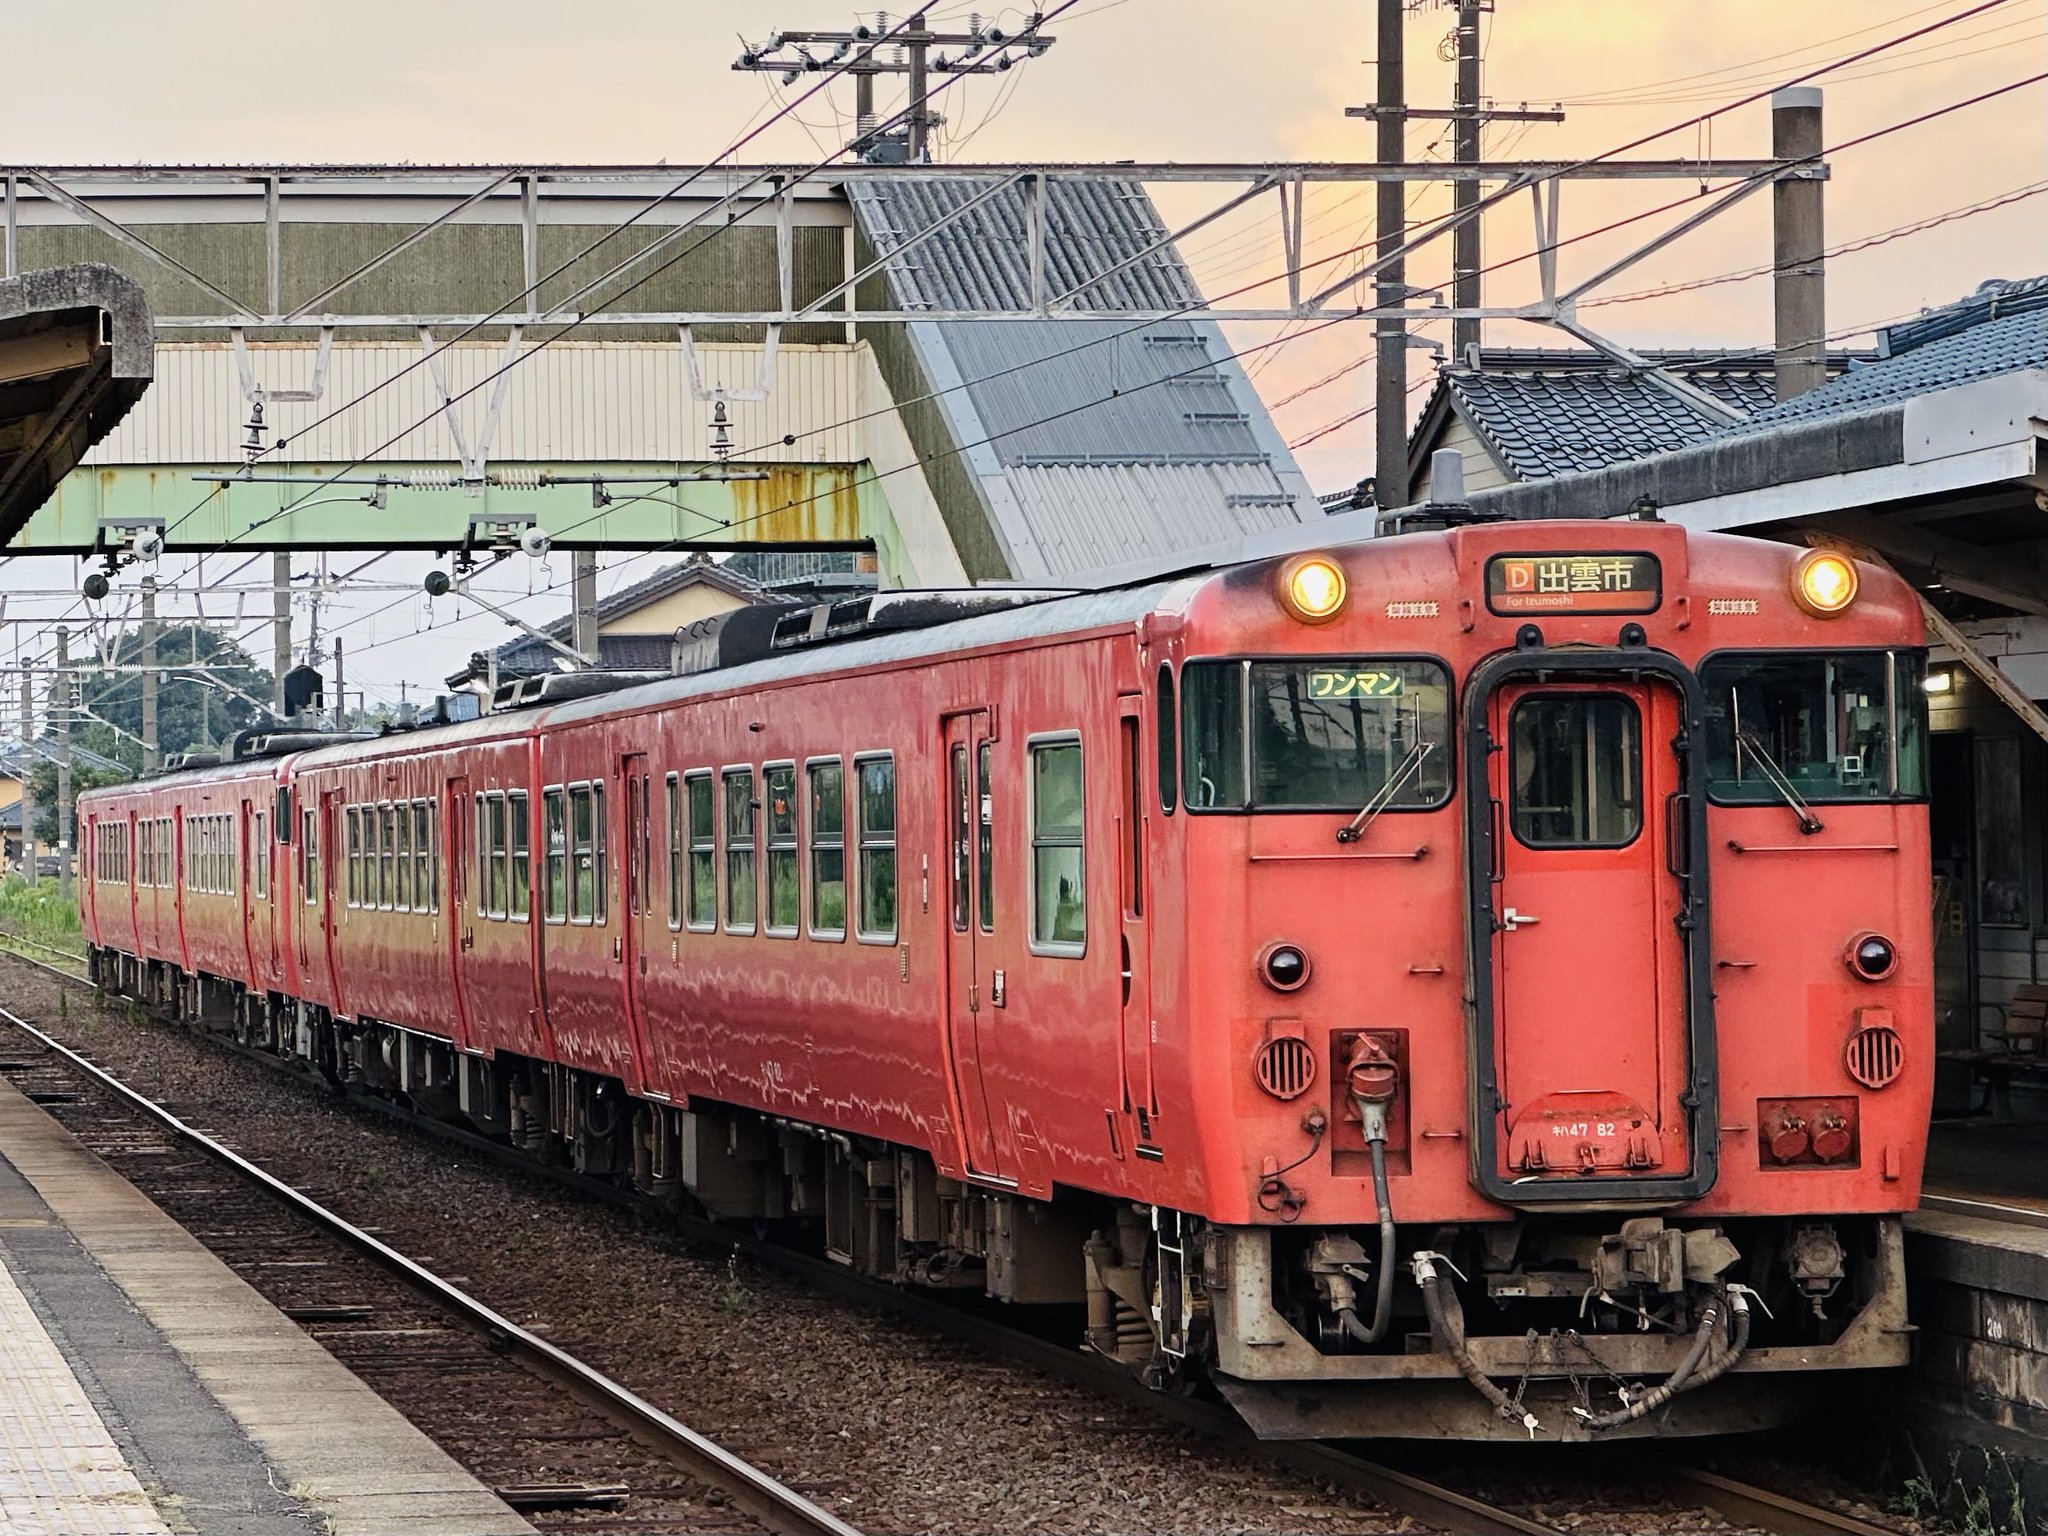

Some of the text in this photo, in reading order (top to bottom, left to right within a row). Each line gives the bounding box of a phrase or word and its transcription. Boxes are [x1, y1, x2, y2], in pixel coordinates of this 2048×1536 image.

[1511, 561, 1634, 593] D 出雲市
[1506, 594, 1574, 607] For Izumoshi
[1312, 672, 1401, 696] ワンマン
[1596, 1122, 1616, 1137] 82
